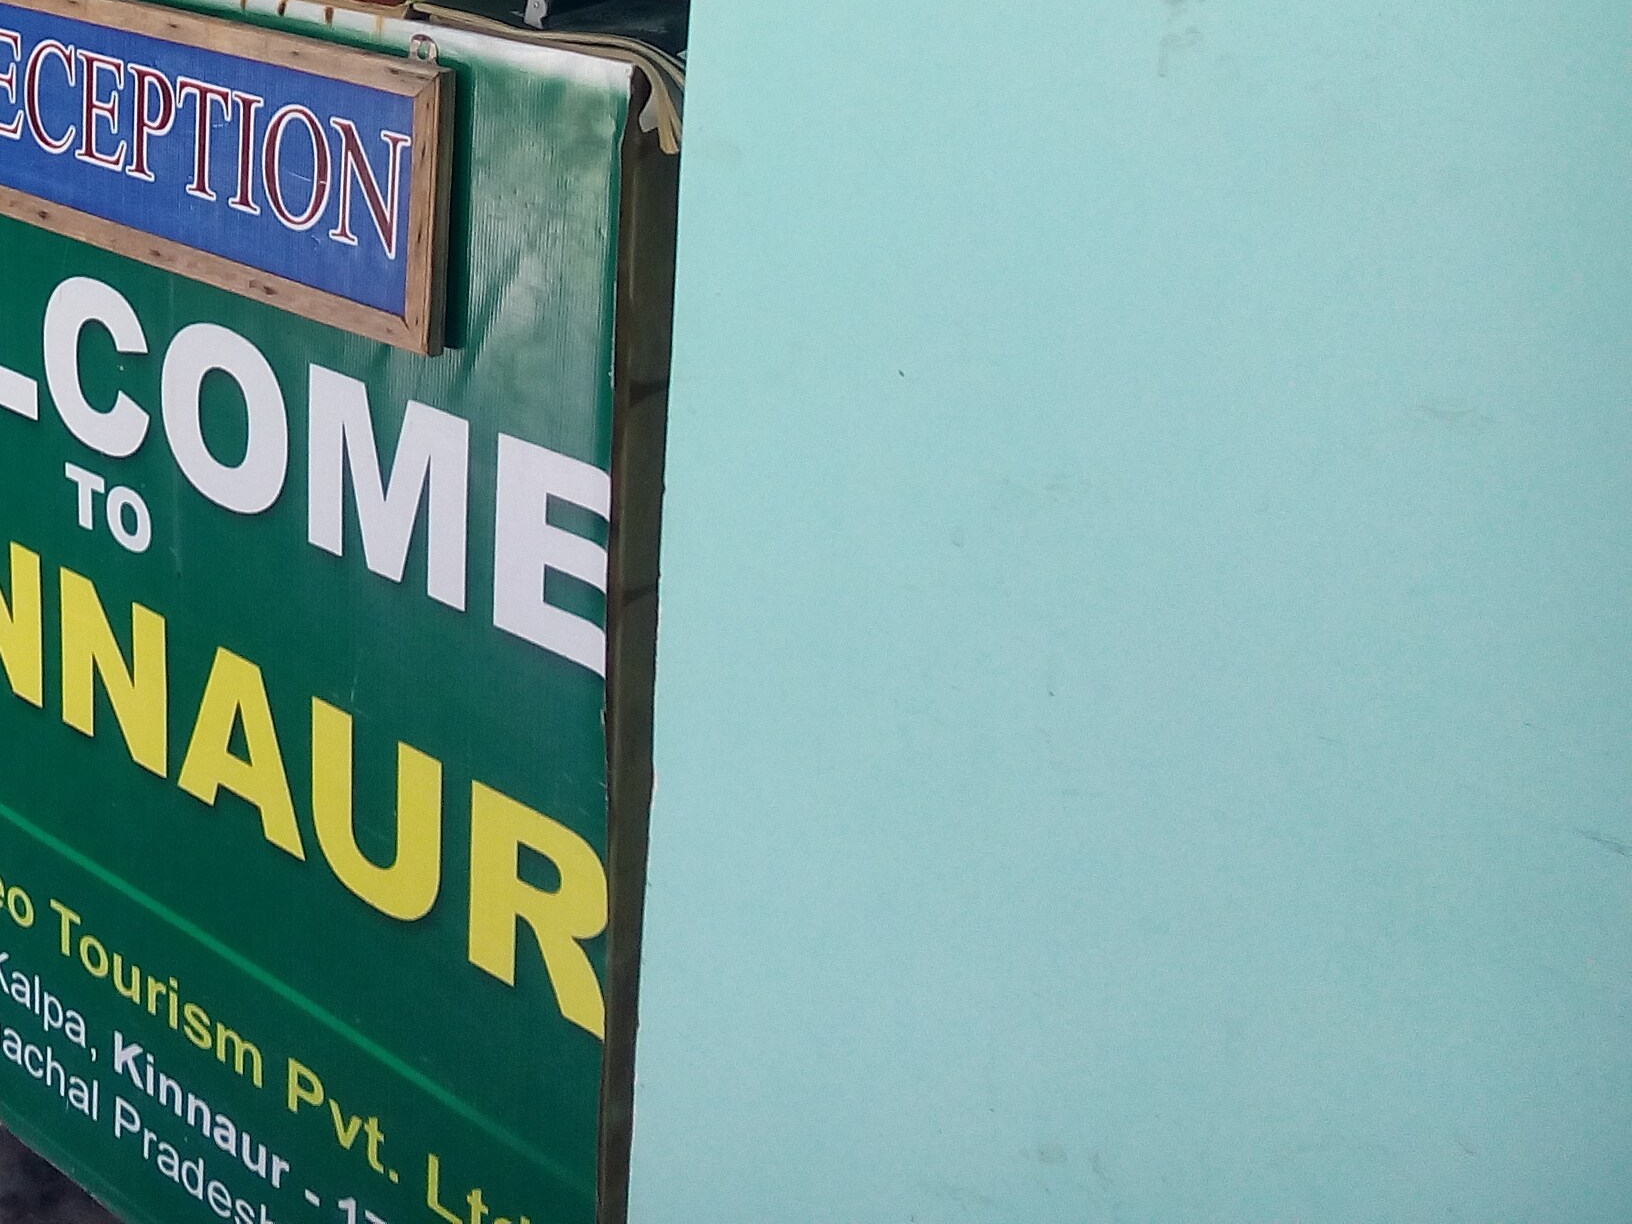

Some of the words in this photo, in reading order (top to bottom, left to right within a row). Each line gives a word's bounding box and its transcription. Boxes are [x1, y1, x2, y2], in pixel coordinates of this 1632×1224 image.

[65, 461, 152, 554] TO
[49, 898, 263, 1089] Tourism
[287, 1057, 400, 1184] Pvt.
[427, 1153, 532, 1224] Lt
[113, 1030, 290, 1189] Kinnaur
